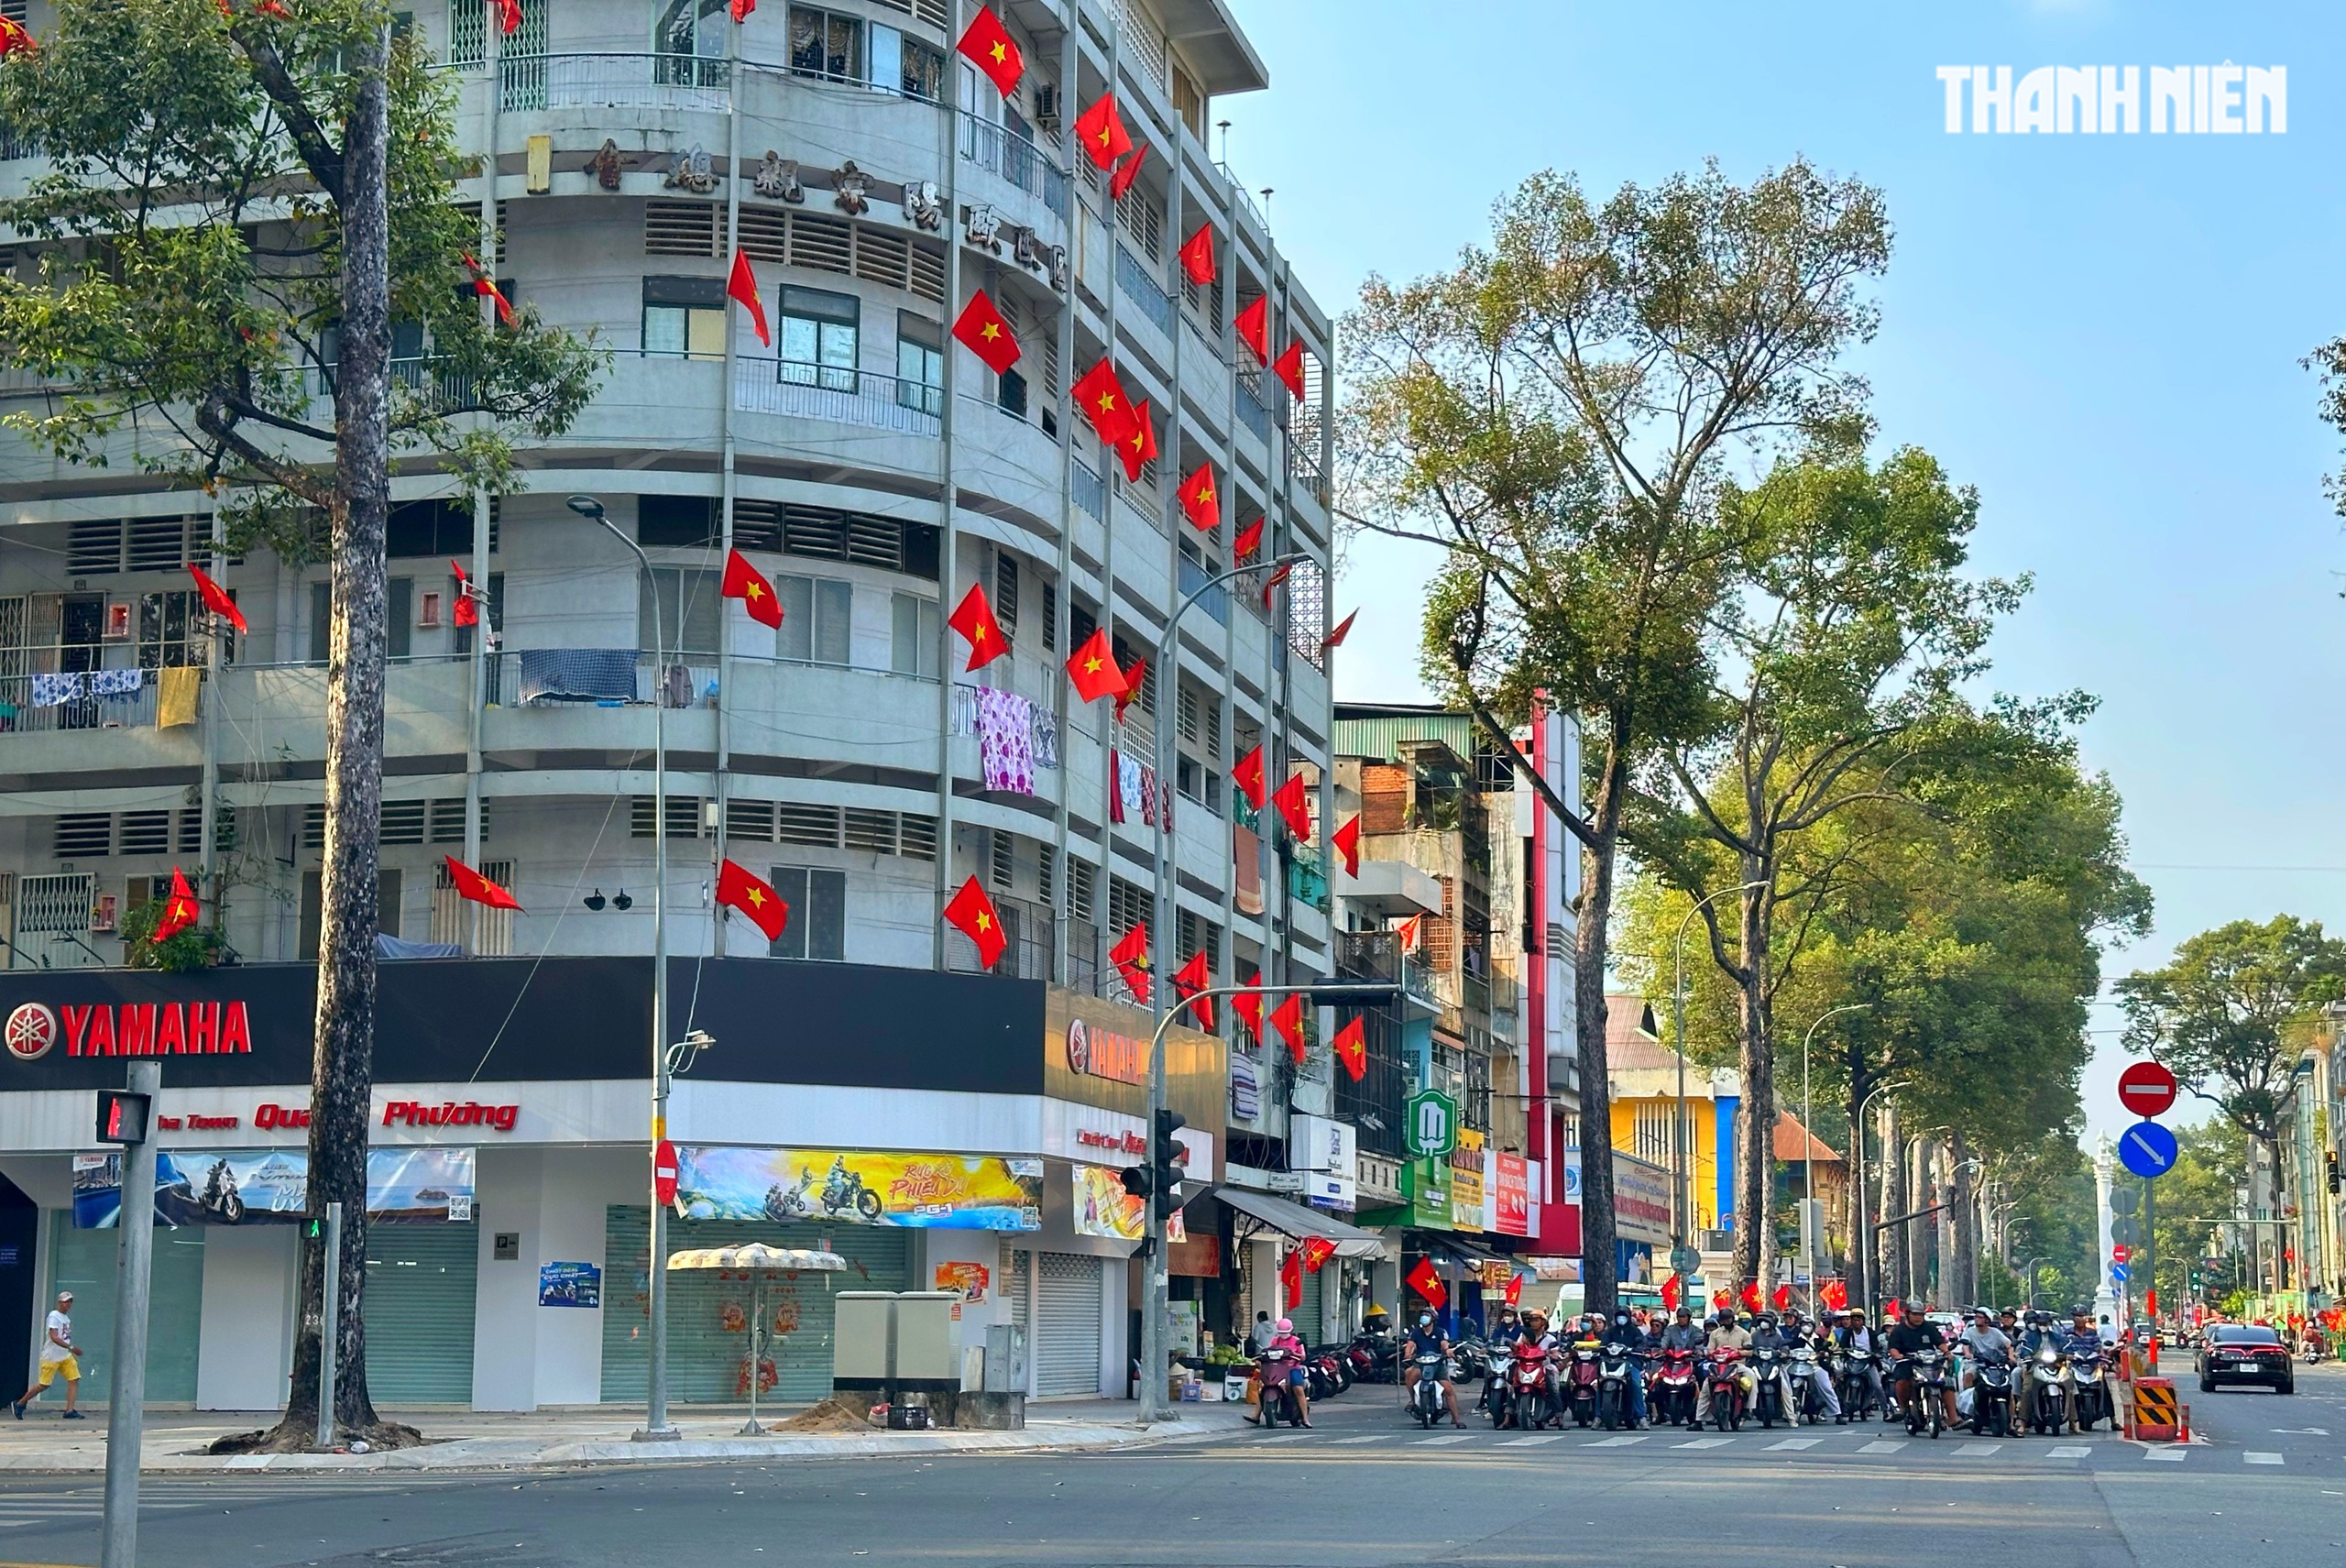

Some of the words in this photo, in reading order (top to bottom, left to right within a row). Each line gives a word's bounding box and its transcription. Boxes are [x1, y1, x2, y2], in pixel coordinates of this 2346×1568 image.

[60, 1001, 252, 1058] YAMAHA
[255, 1103, 311, 1131] Qua
[382, 1102, 520, 1131] Phương
[913, 1202, 953, 1216] PG-1
